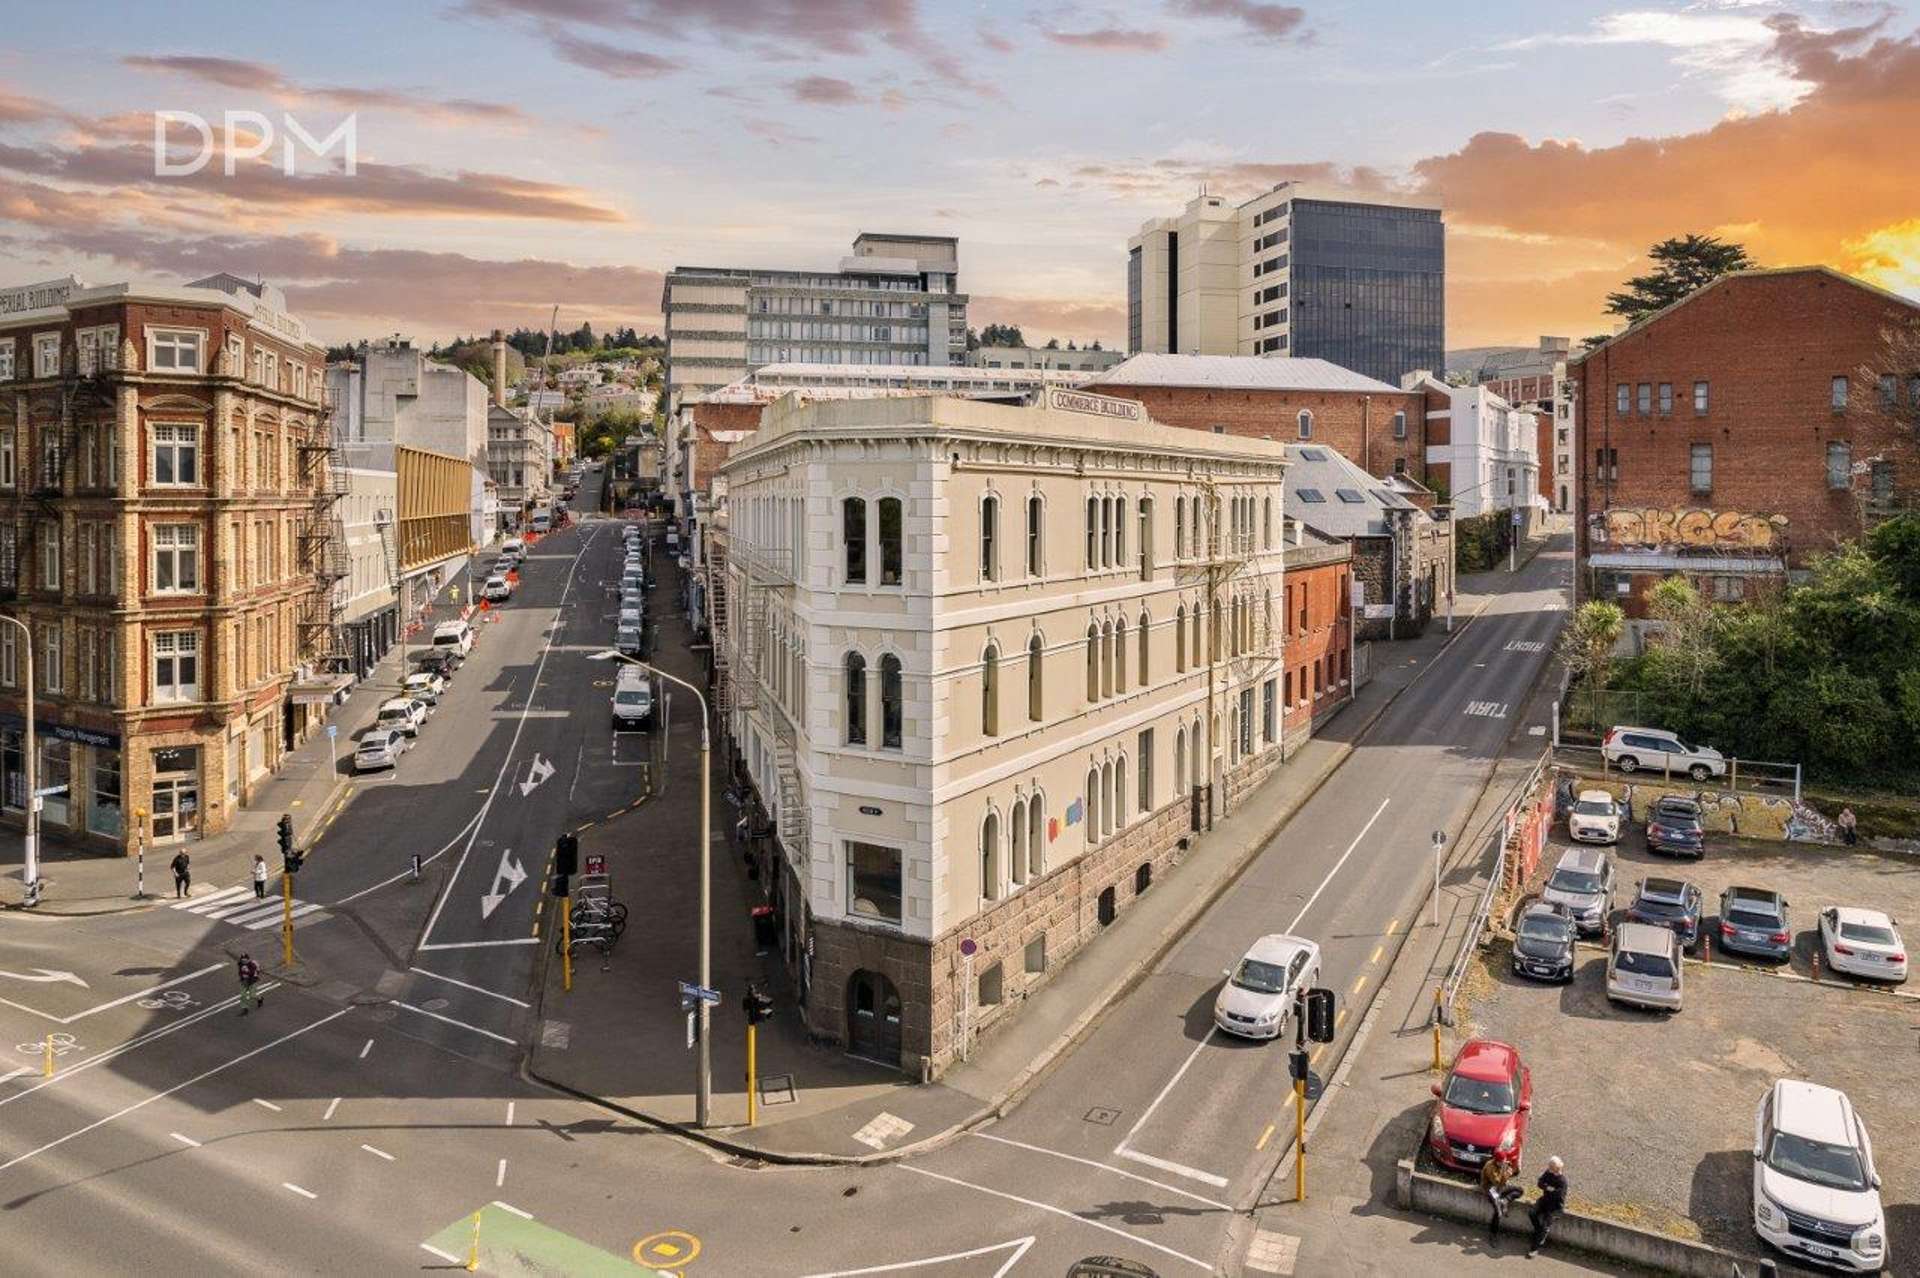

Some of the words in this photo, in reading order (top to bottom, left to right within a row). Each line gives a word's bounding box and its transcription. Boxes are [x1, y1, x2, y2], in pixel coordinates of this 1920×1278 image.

[1056, 391, 1099, 413] COMMERCE
[1101, 399, 1136, 418] BUILDING
[1503, 640, 1545, 653] RIGHT
[1464, 701, 1508, 718] TURN
